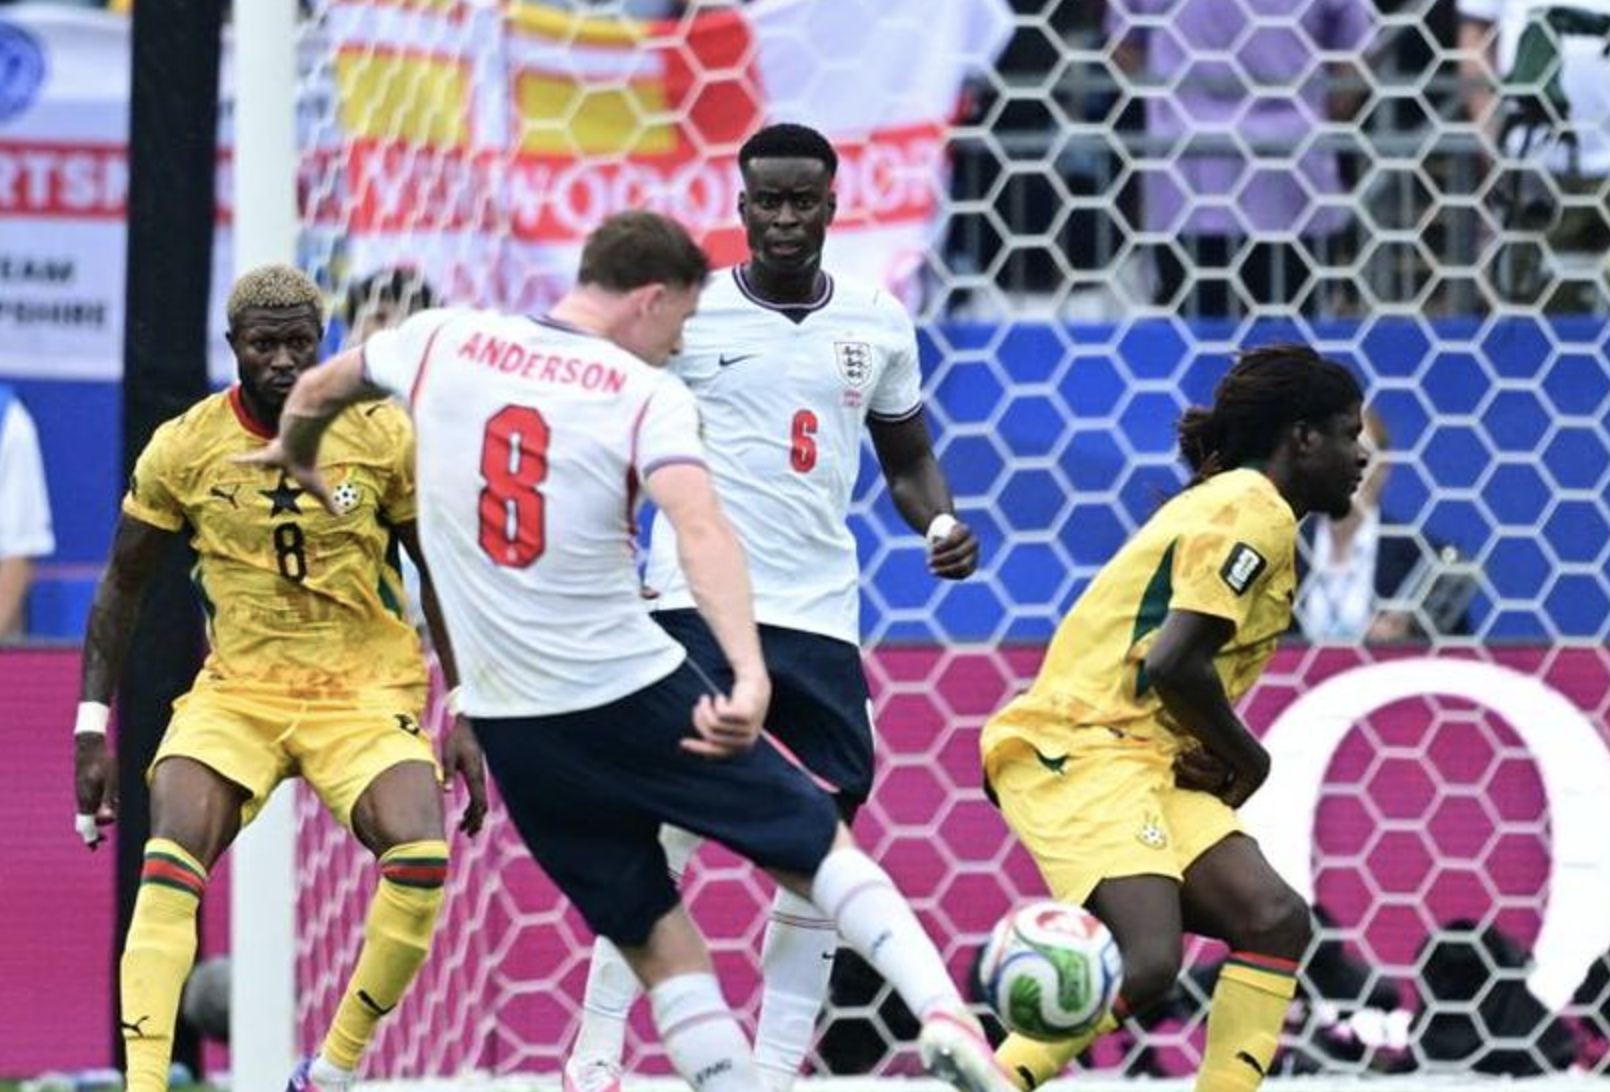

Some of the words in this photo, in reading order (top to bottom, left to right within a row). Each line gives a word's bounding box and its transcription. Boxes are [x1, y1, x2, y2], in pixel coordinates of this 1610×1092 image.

[458, 332, 627, 394] ANDERSON
[790, 409, 818, 474] 6
[478, 403, 551, 570] 8
[273, 522, 308, 582] 8
